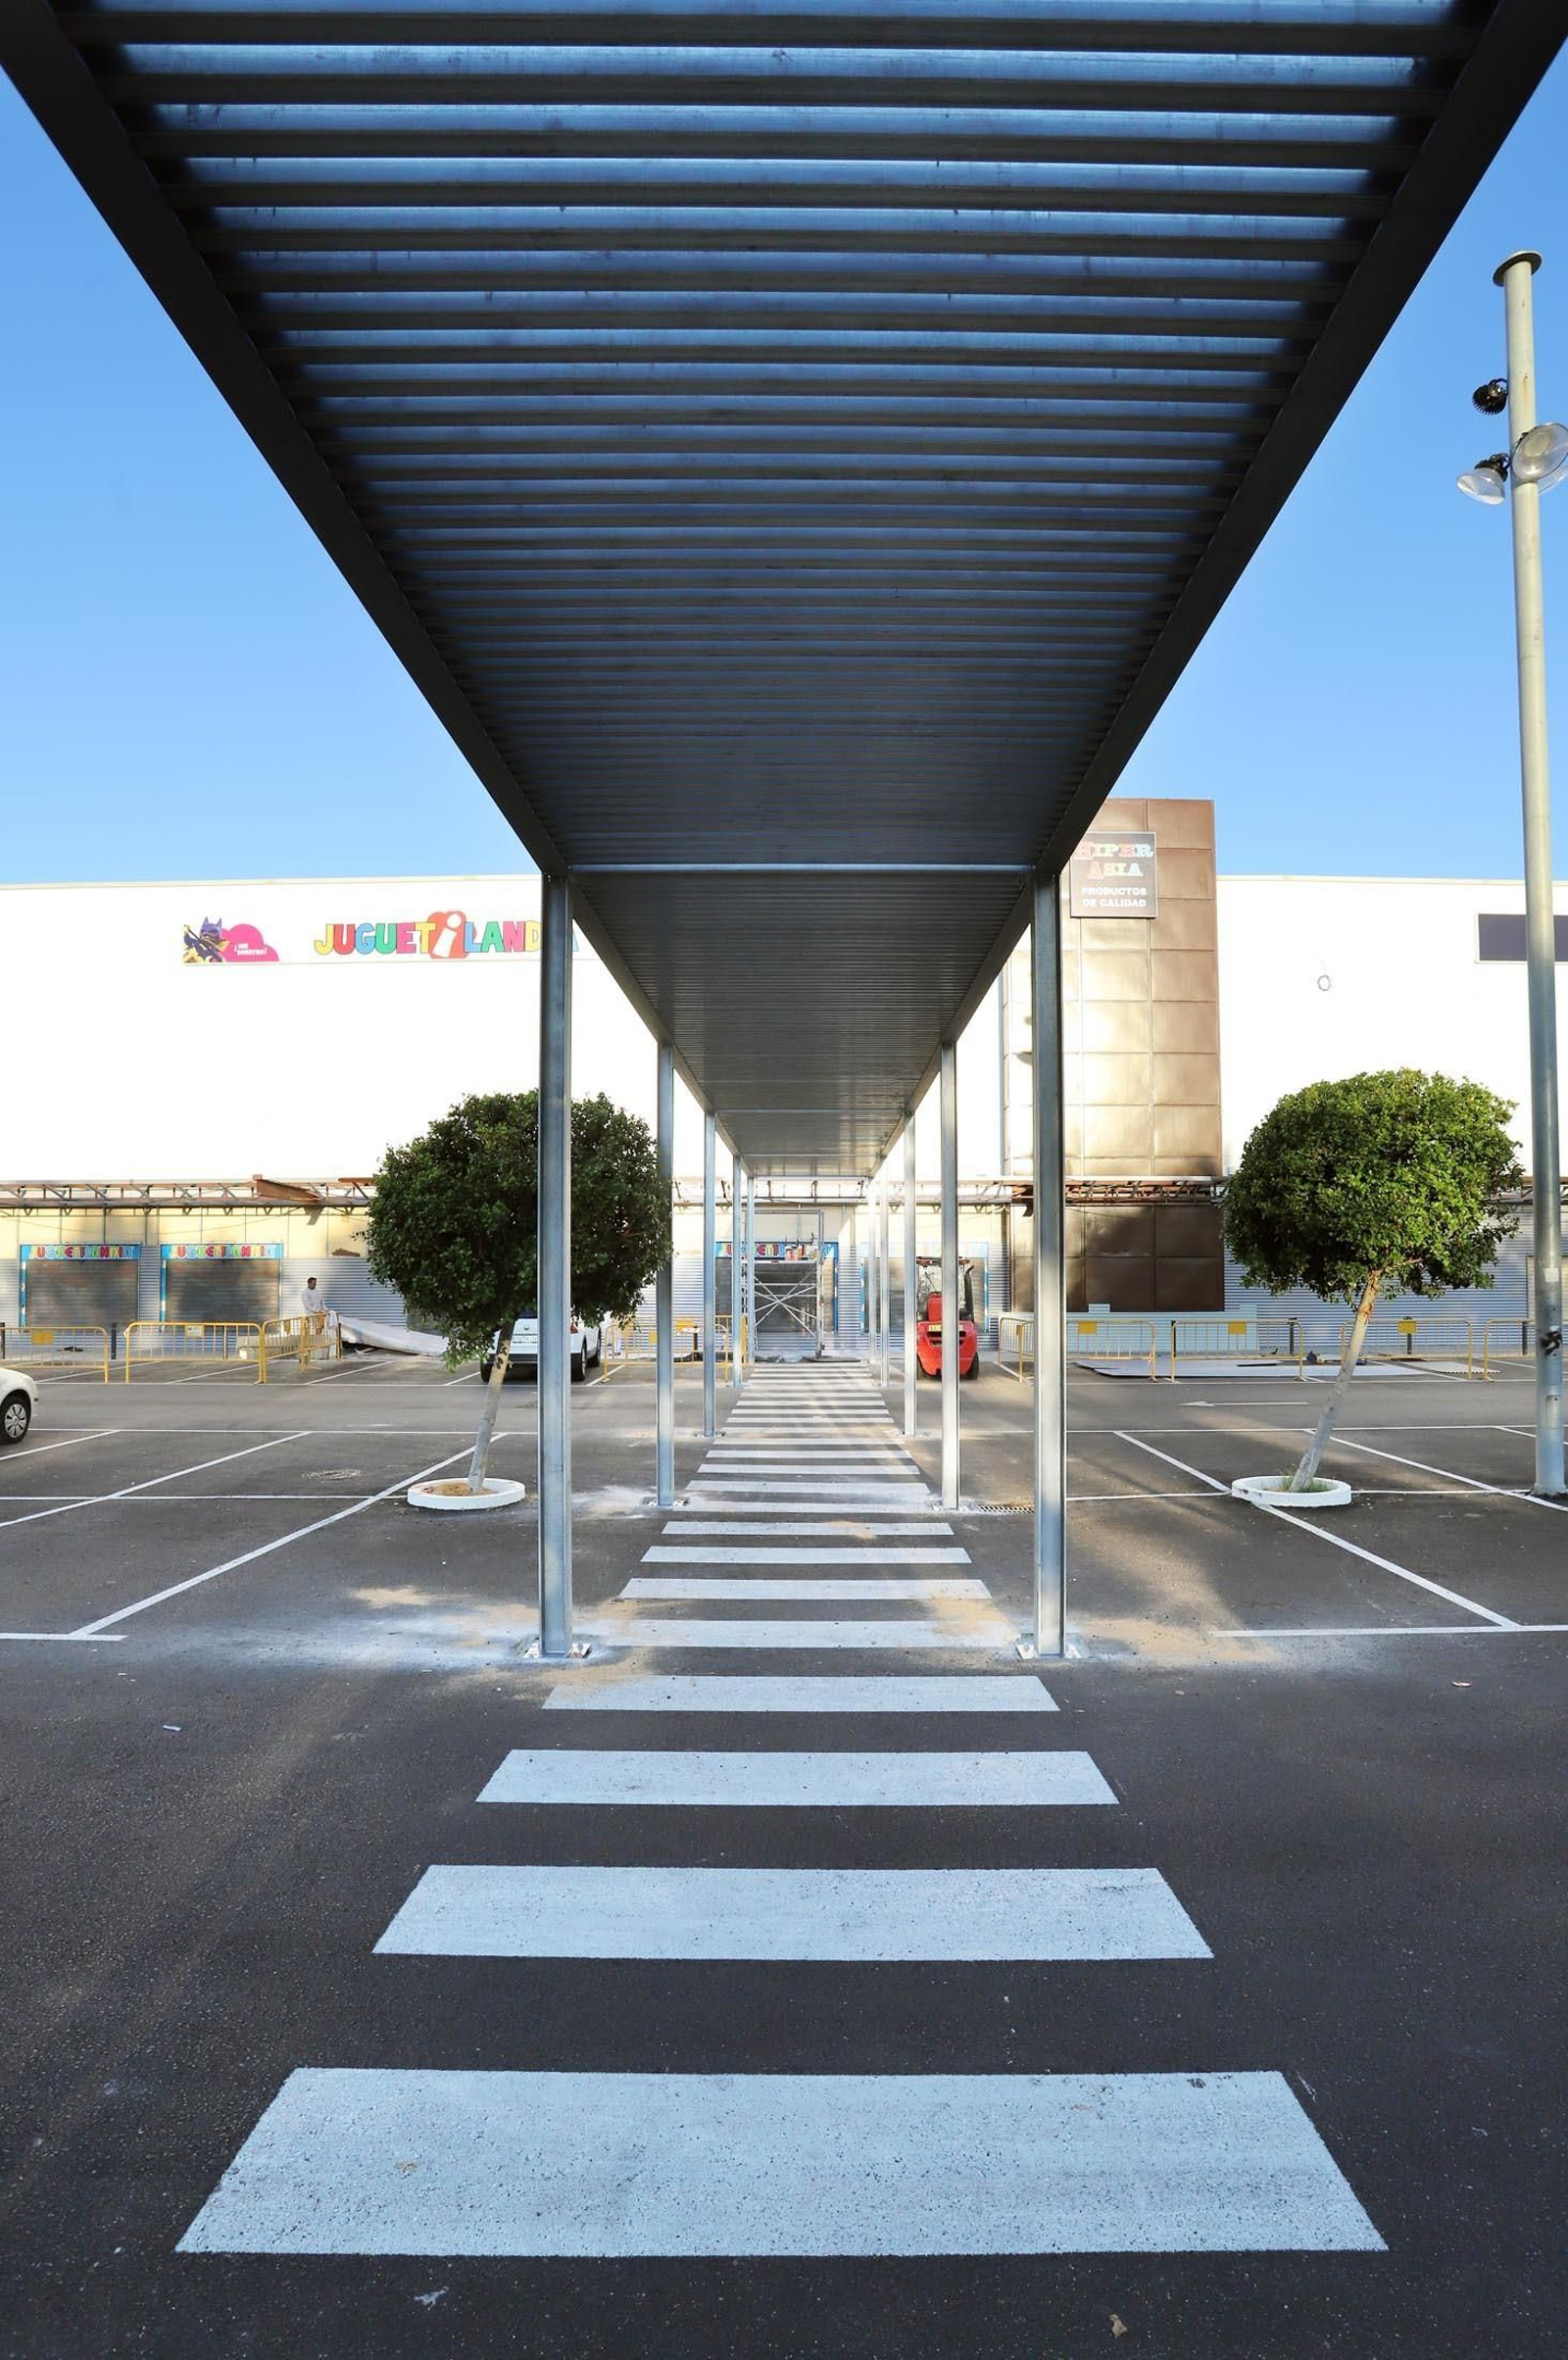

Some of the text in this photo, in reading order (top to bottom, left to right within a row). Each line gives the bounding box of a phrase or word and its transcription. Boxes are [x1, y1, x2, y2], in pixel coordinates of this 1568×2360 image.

[1087, 860, 1144, 879] ASIA
[1080, 886, 1148, 896] PRODUCTOS
[1082, 898, 1147, 908] DE CALIDAD
